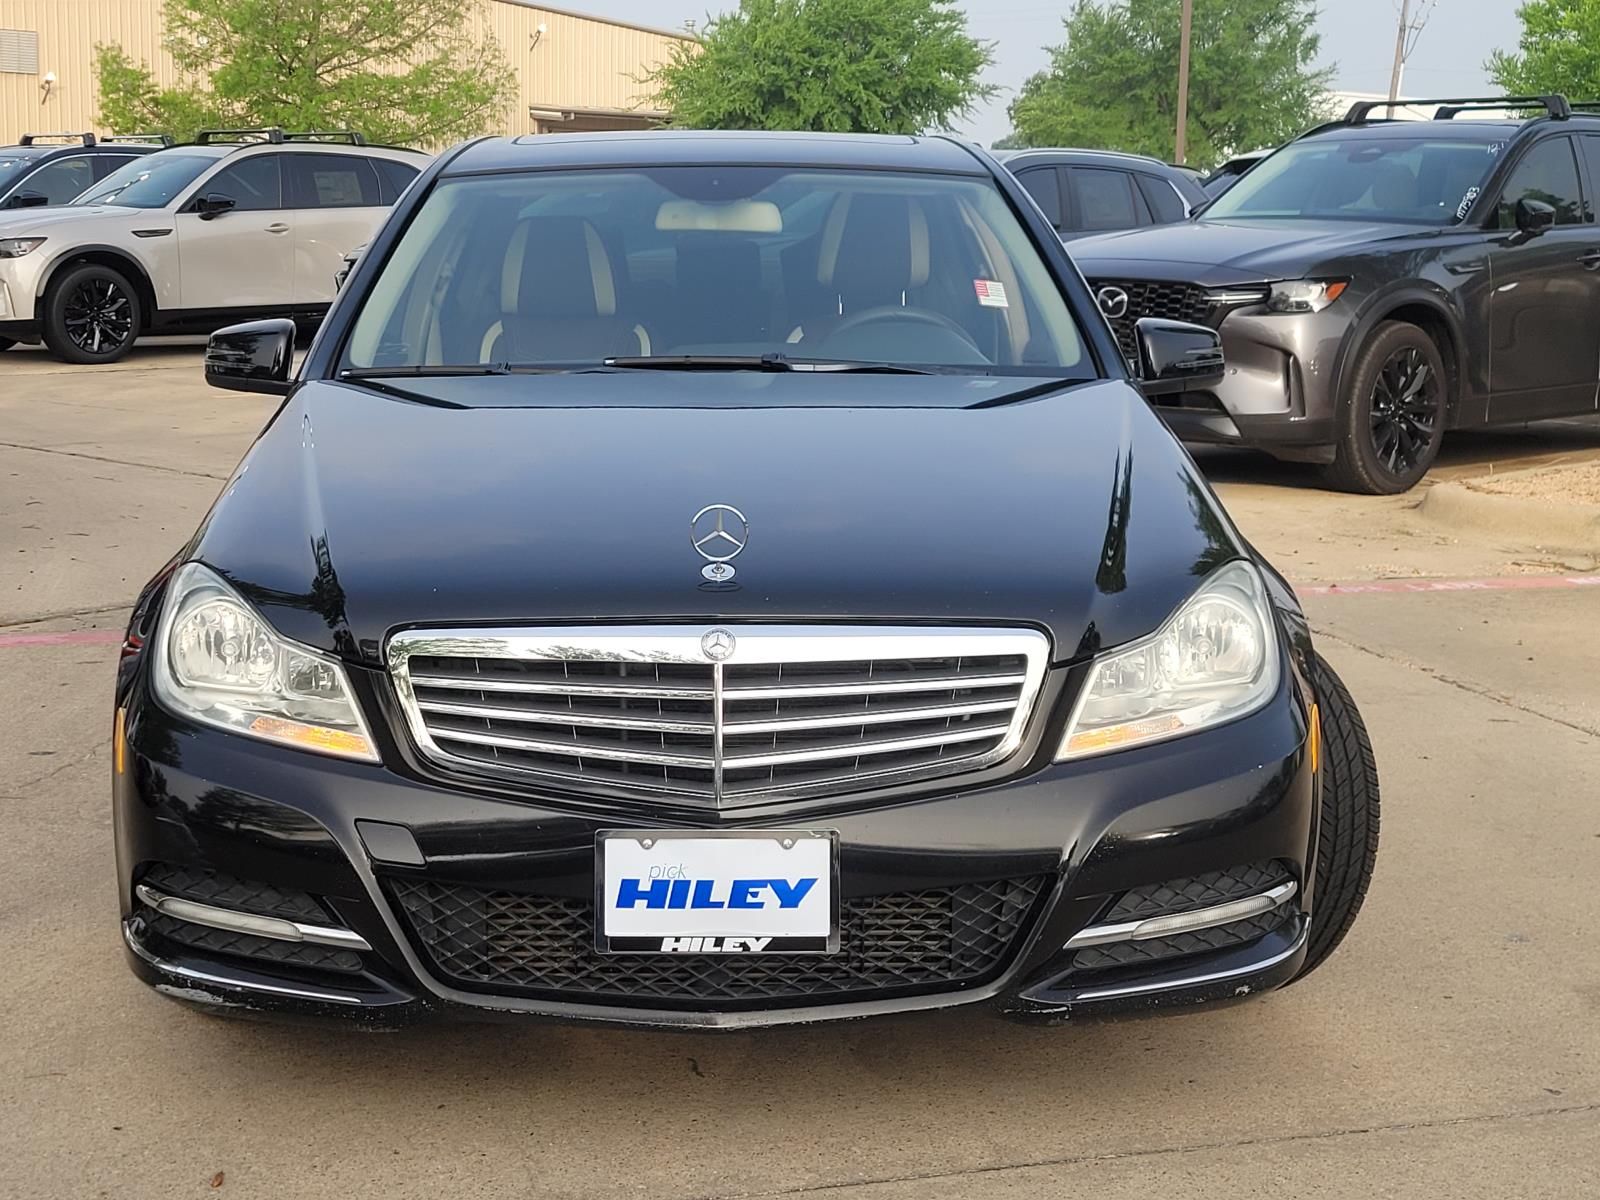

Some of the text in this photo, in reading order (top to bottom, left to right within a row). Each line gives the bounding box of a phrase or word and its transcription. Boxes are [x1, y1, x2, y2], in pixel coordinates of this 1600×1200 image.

[648, 863, 687, 882] pick
[615, 878, 818, 909] HILEY
[660, 937, 773, 952] HILEY
